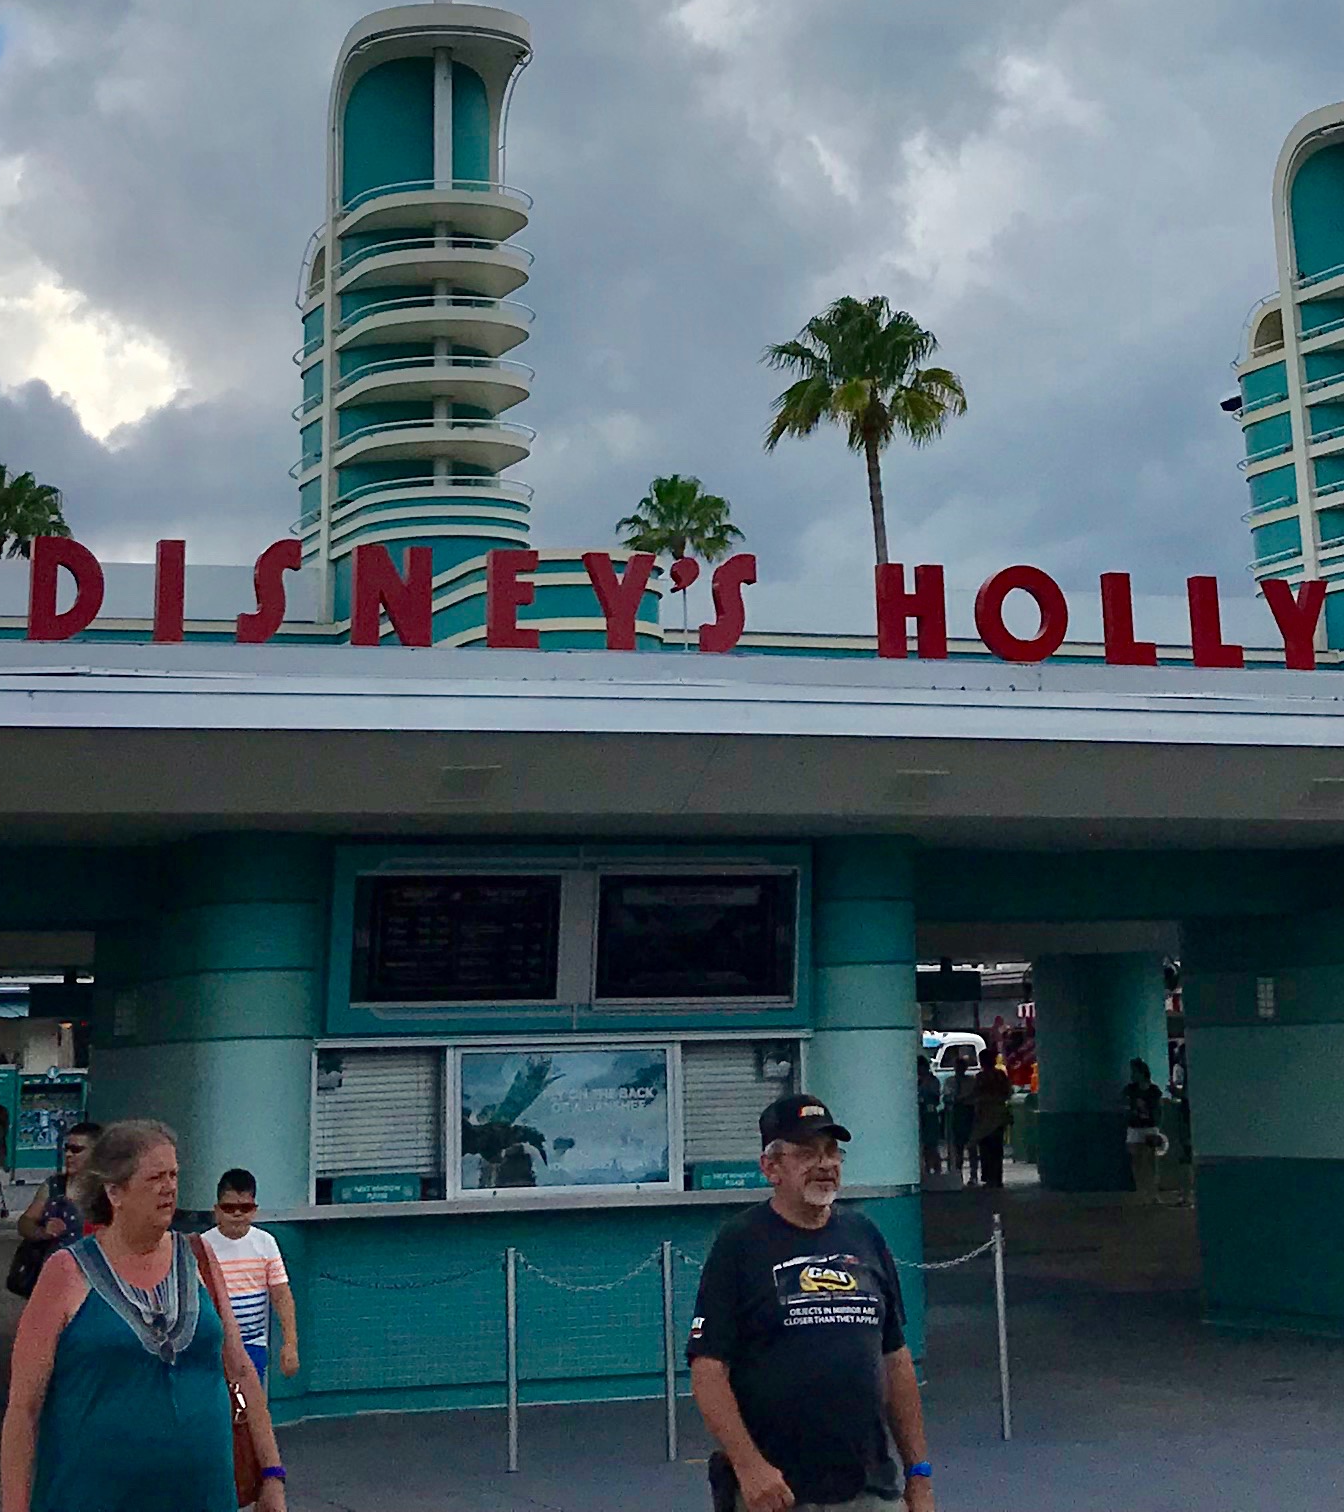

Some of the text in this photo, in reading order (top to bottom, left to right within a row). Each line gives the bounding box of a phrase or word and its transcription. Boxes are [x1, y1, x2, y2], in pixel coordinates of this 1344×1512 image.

[27, 535, 757, 653] DISNEY'S
[619, 1087, 655, 1099] BACK
[807, 1266, 850, 1284] CAT
[789, 1306, 822, 1316] OBJECTS
[823, 1306, 832, 1315] IN
[862, 1306, 876, 1316] ARE
[783, 1316, 814, 1326] CLOSER
[814, 1315, 836, 1325] THAN
[836, 1315, 855, 1323] THEY
